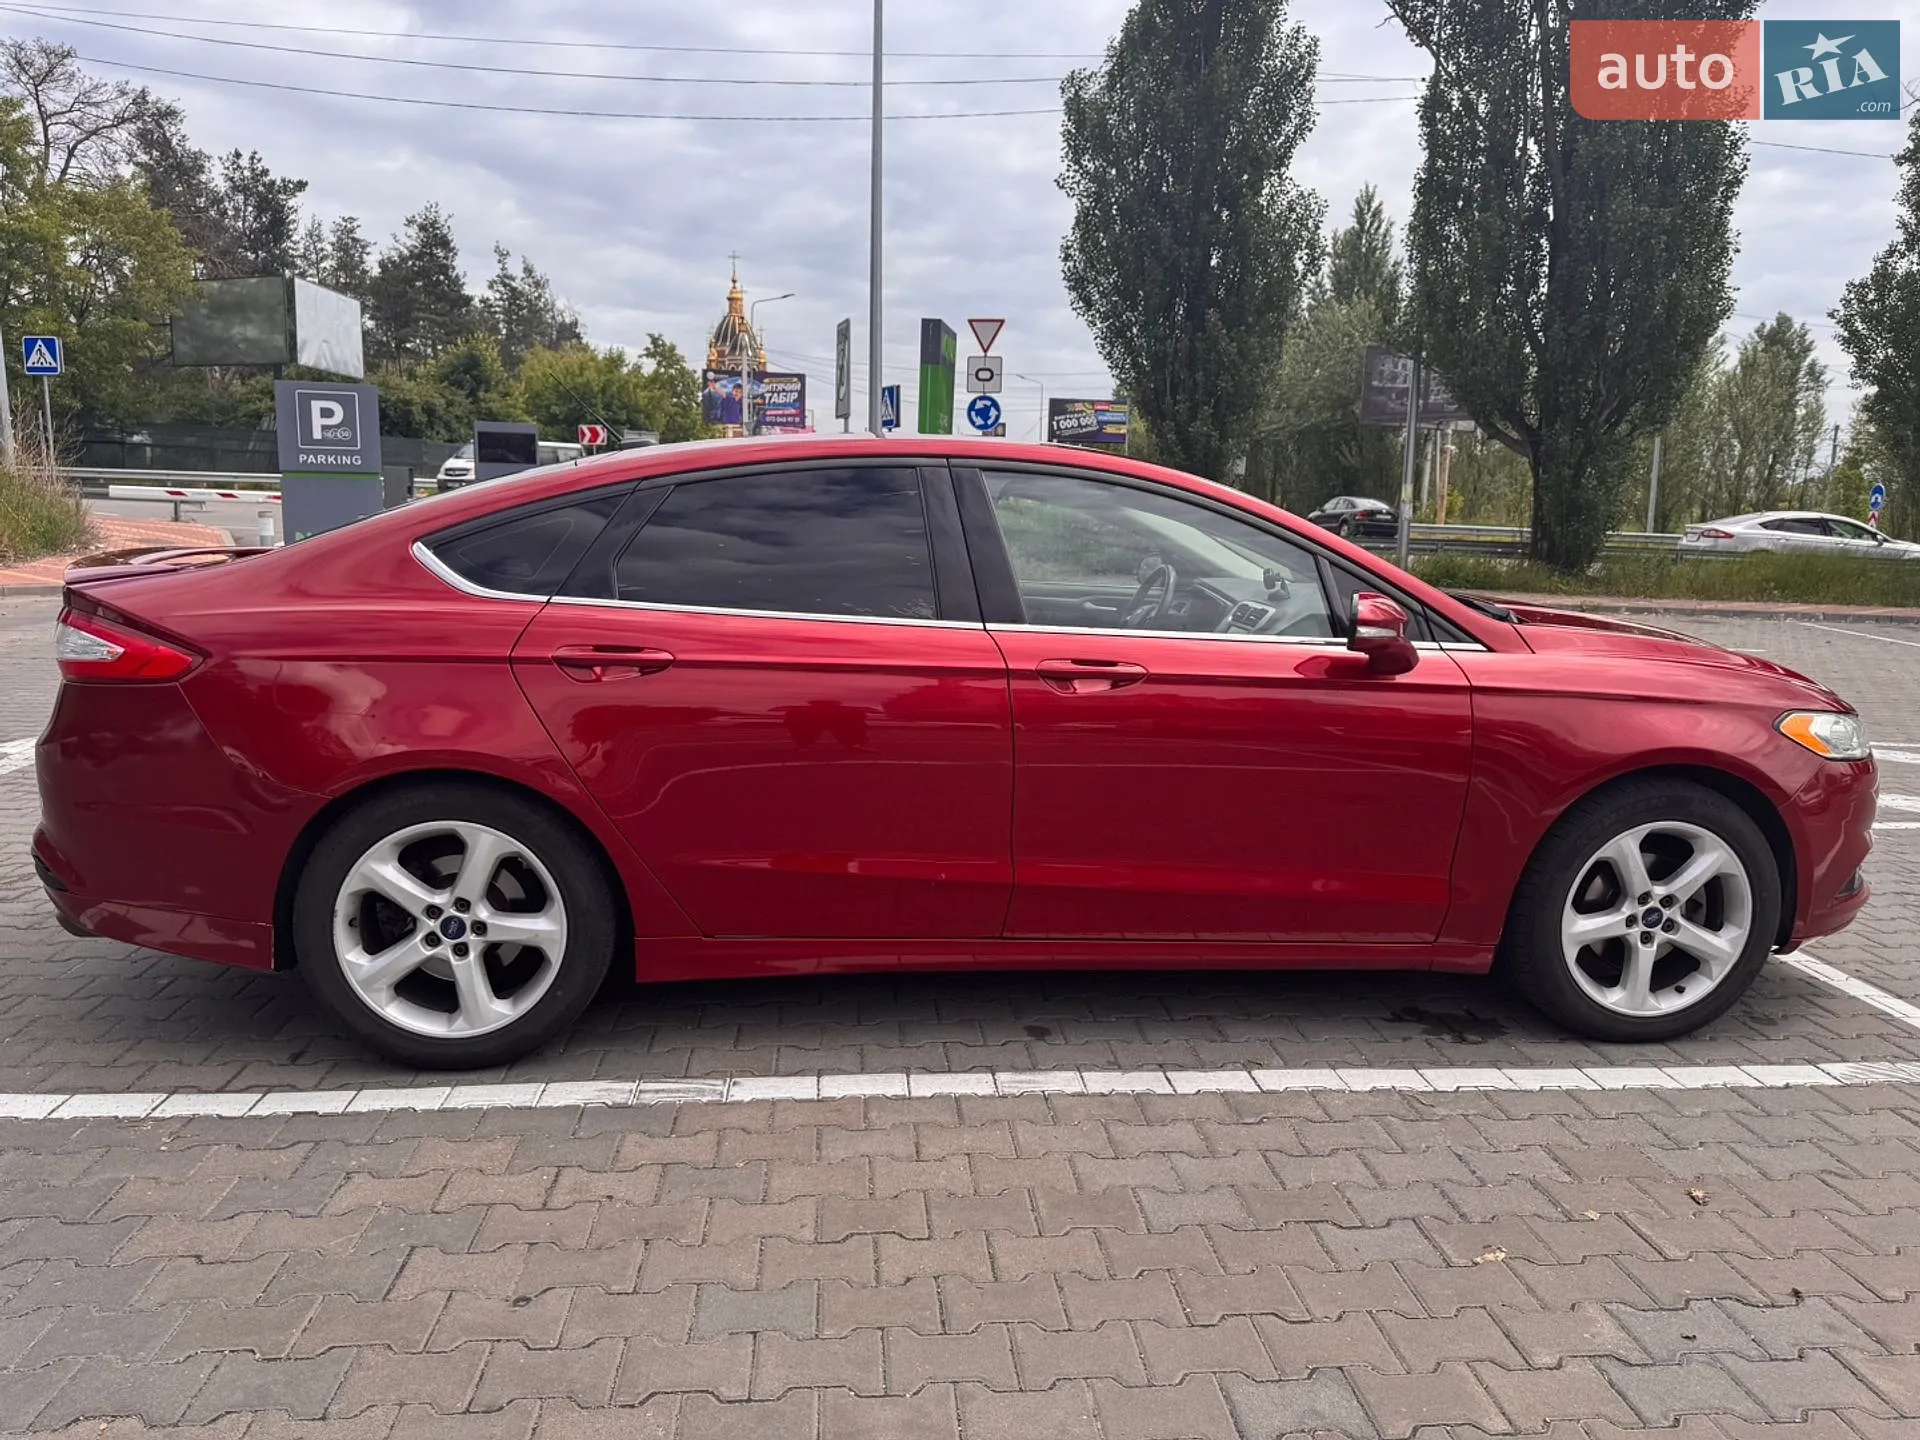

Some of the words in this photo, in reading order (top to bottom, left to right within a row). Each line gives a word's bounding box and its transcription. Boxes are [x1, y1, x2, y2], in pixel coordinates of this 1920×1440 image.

[760, 382, 801, 392] ДИТЯЧИЙ
[764, 392, 798, 404] ТАБІР
[311, 400, 344, 439] P
[299, 454, 362, 465] PARKING
